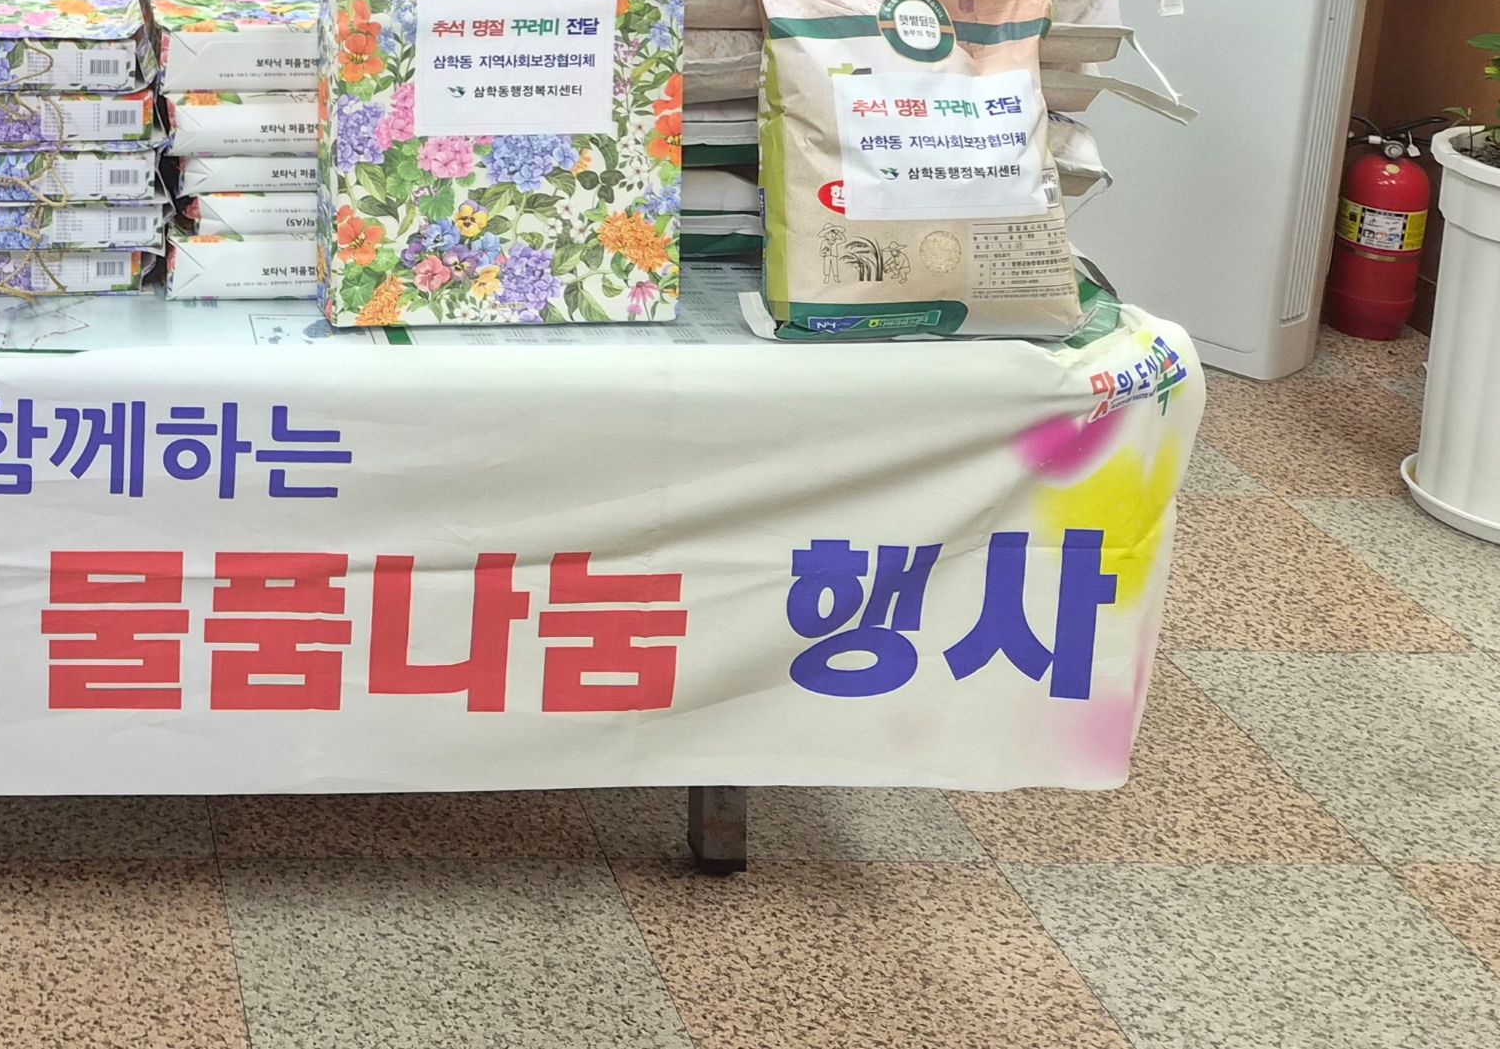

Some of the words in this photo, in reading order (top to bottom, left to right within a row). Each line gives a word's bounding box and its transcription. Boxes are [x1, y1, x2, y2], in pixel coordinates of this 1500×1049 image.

[431, 19, 465, 37] 추석
[472, 19, 505, 36] 명절
[510, 18, 560, 36] 꾸러미
[566, 17, 600, 35] 전달
[256, 58, 282, 69] 보타닉
[433, 54, 472, 69] 삼학동
[479, 53, 596, 68] 지역사회보장협의체
[474, 84, 583, 98] 삼학동행정복지센터
[853, 99, 888, 117] 추석
[894, 98, 928, 117] 명절
[933, 99, 980, 119] 꾸러미
[985, 96, 1022, 116] 전달
[260, 124, 286, 134] 보타닉
[860, 135, 902, 150] 삼학동
[909, 131, 1027, 150] 지역사회보장협의체
[271, 169, 297, 179] 보타닉
[908, 165, 1021, 180] 삼학동행정복지센터
[262, 266, 287, 276] 보타닉
[41, 551, 688, 712] 물품나눔
[786, 529, 1118, 700] 행사
